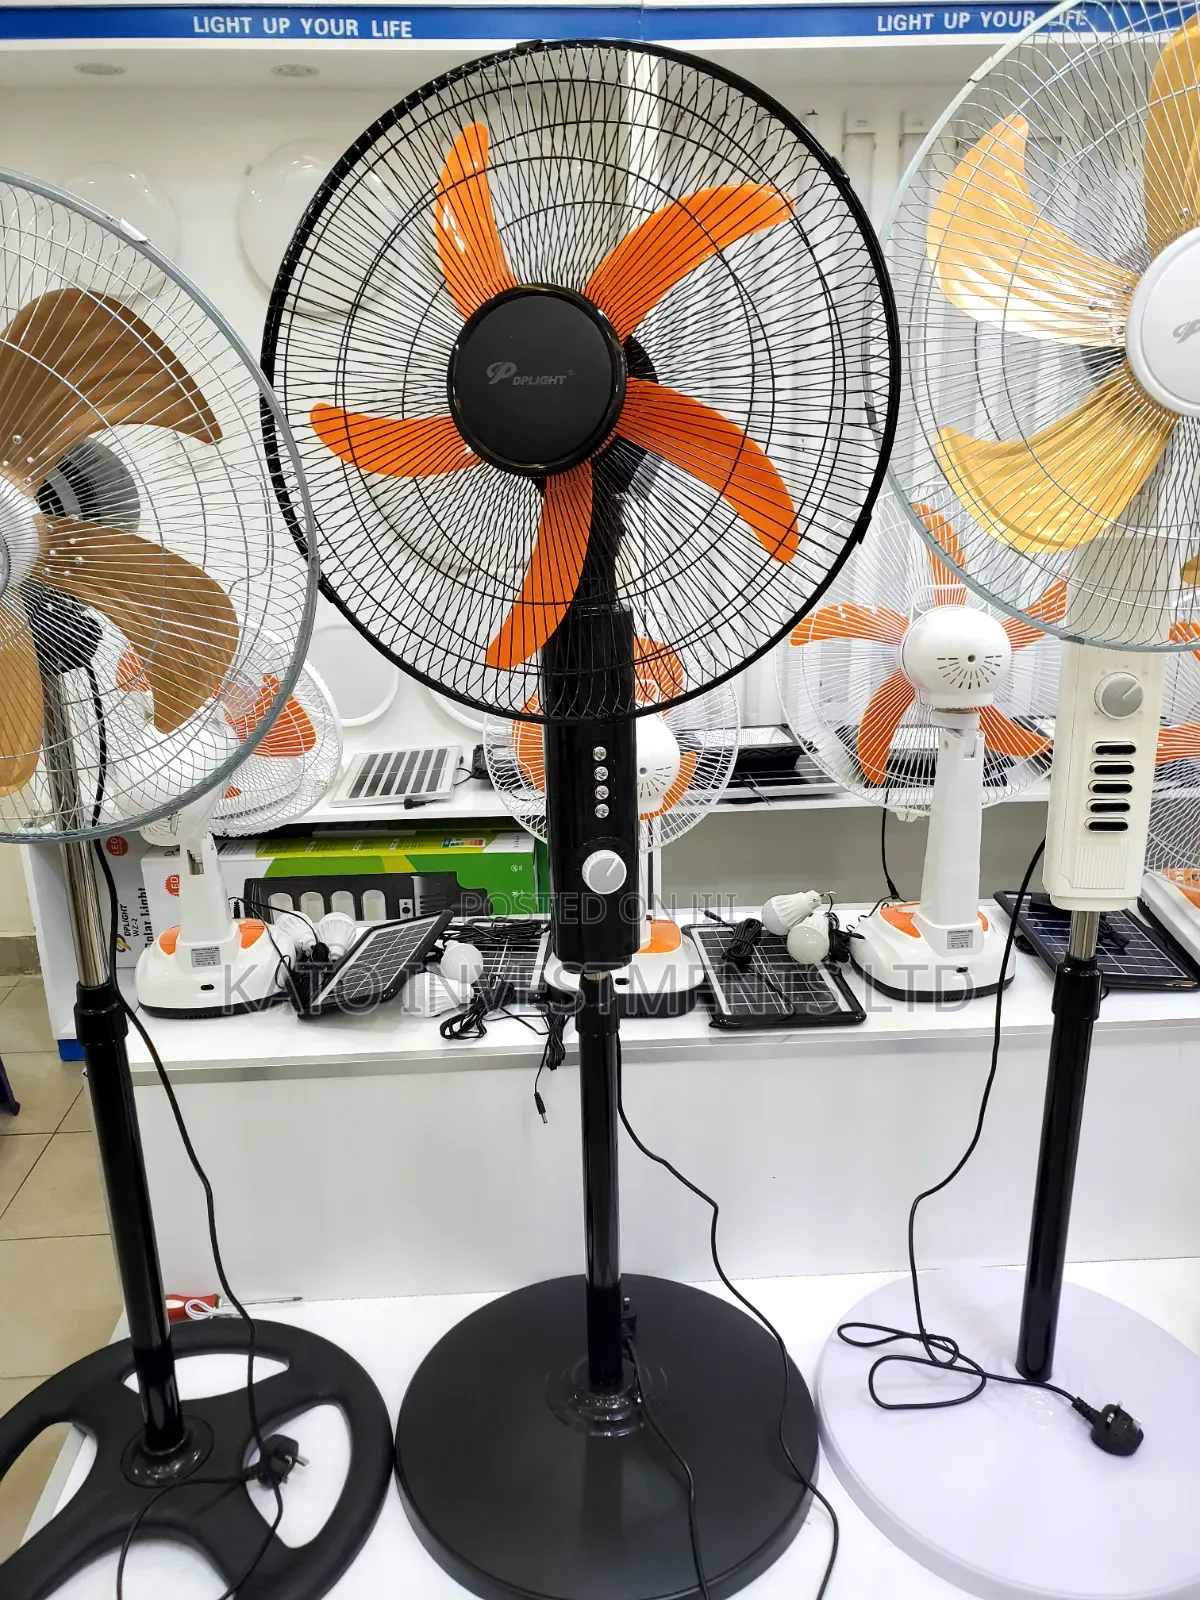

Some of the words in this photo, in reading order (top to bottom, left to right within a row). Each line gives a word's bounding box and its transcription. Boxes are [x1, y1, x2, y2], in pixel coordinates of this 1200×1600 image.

[193, 16, 252, 33] LIGHT
[263, 17, 291, 34] UP
[300, 18, 359, 36] YOUR
[372, 20, 413, 38] LIFE
[877, 14, 935, 32] LIGHT
[943, 13, 971, 30] UP
[980, 10, 1036, 28] YOUR
[111, 837, 120, 855] LED
[119, 903, 132, 937] DPLIGHT
[131, 917, 140, 937] WZ-2
